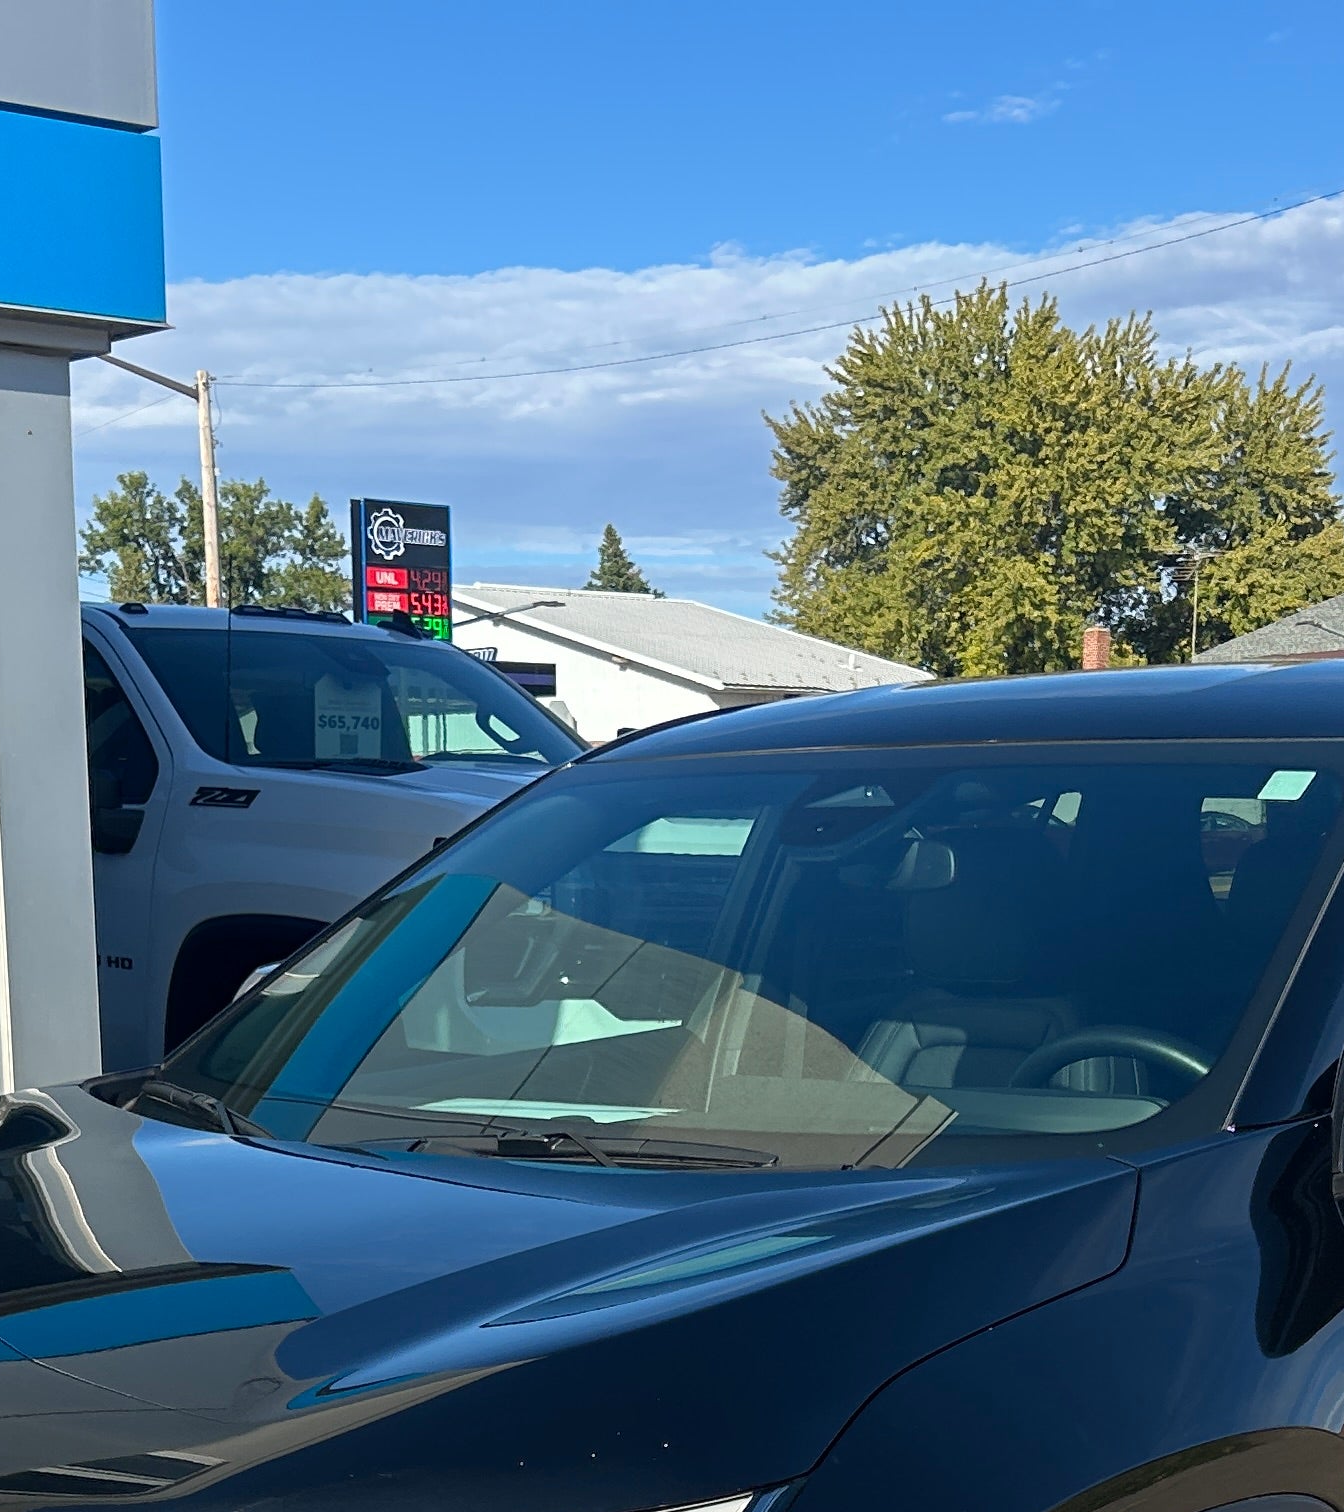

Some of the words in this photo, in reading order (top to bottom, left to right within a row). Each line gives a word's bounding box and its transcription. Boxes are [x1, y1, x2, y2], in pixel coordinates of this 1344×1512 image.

[376, 571, 399, 585] UNL
[374, 600, 401, 612] PREM
[318, 714, 380, 731] $65,740
[107, 955, 134, 970] HD
